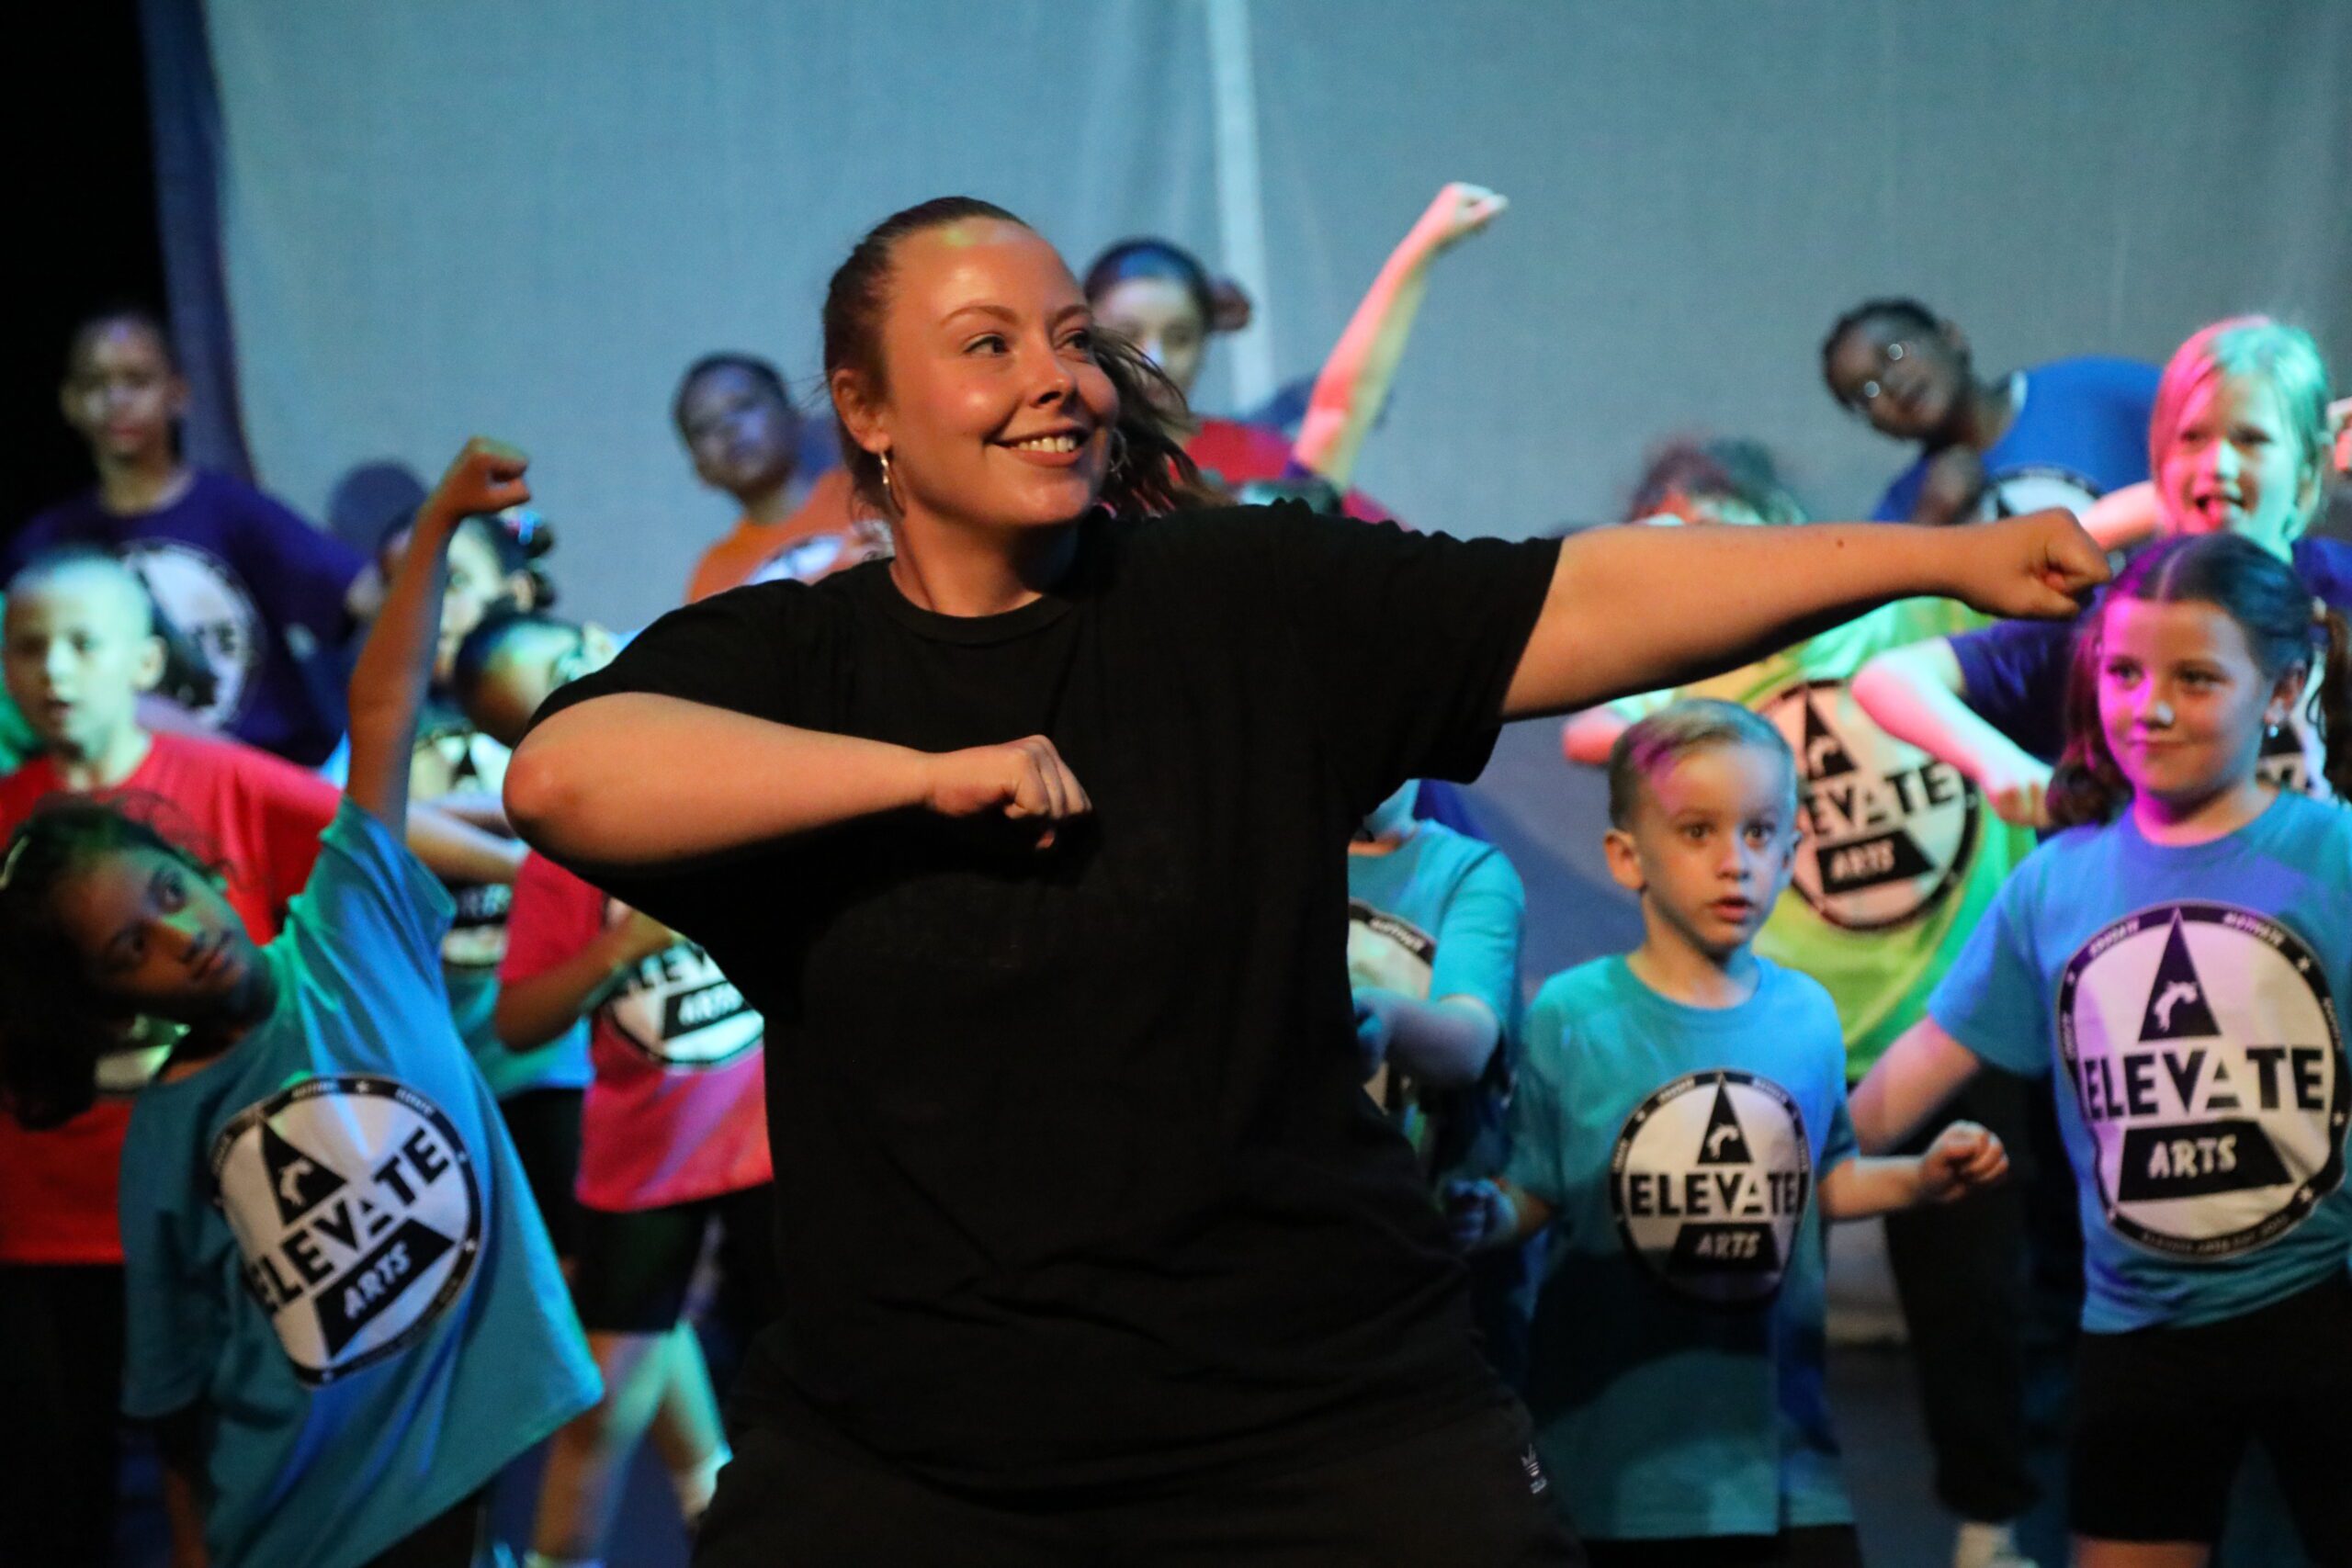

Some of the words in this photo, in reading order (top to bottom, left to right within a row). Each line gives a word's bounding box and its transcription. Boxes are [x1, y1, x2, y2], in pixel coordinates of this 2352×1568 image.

[1803, 761, 1956, 837] EVATE
[2083, 1047, 2325, 1122] ELEVATE
[2148, 1134, 2238, 1181] ARTS
[1629, 1172, 1796, 1216] ELEVATE
[1695, 1230, 1761, 1259] ARTS
[343, 1241, 413, 1320] ARTS
